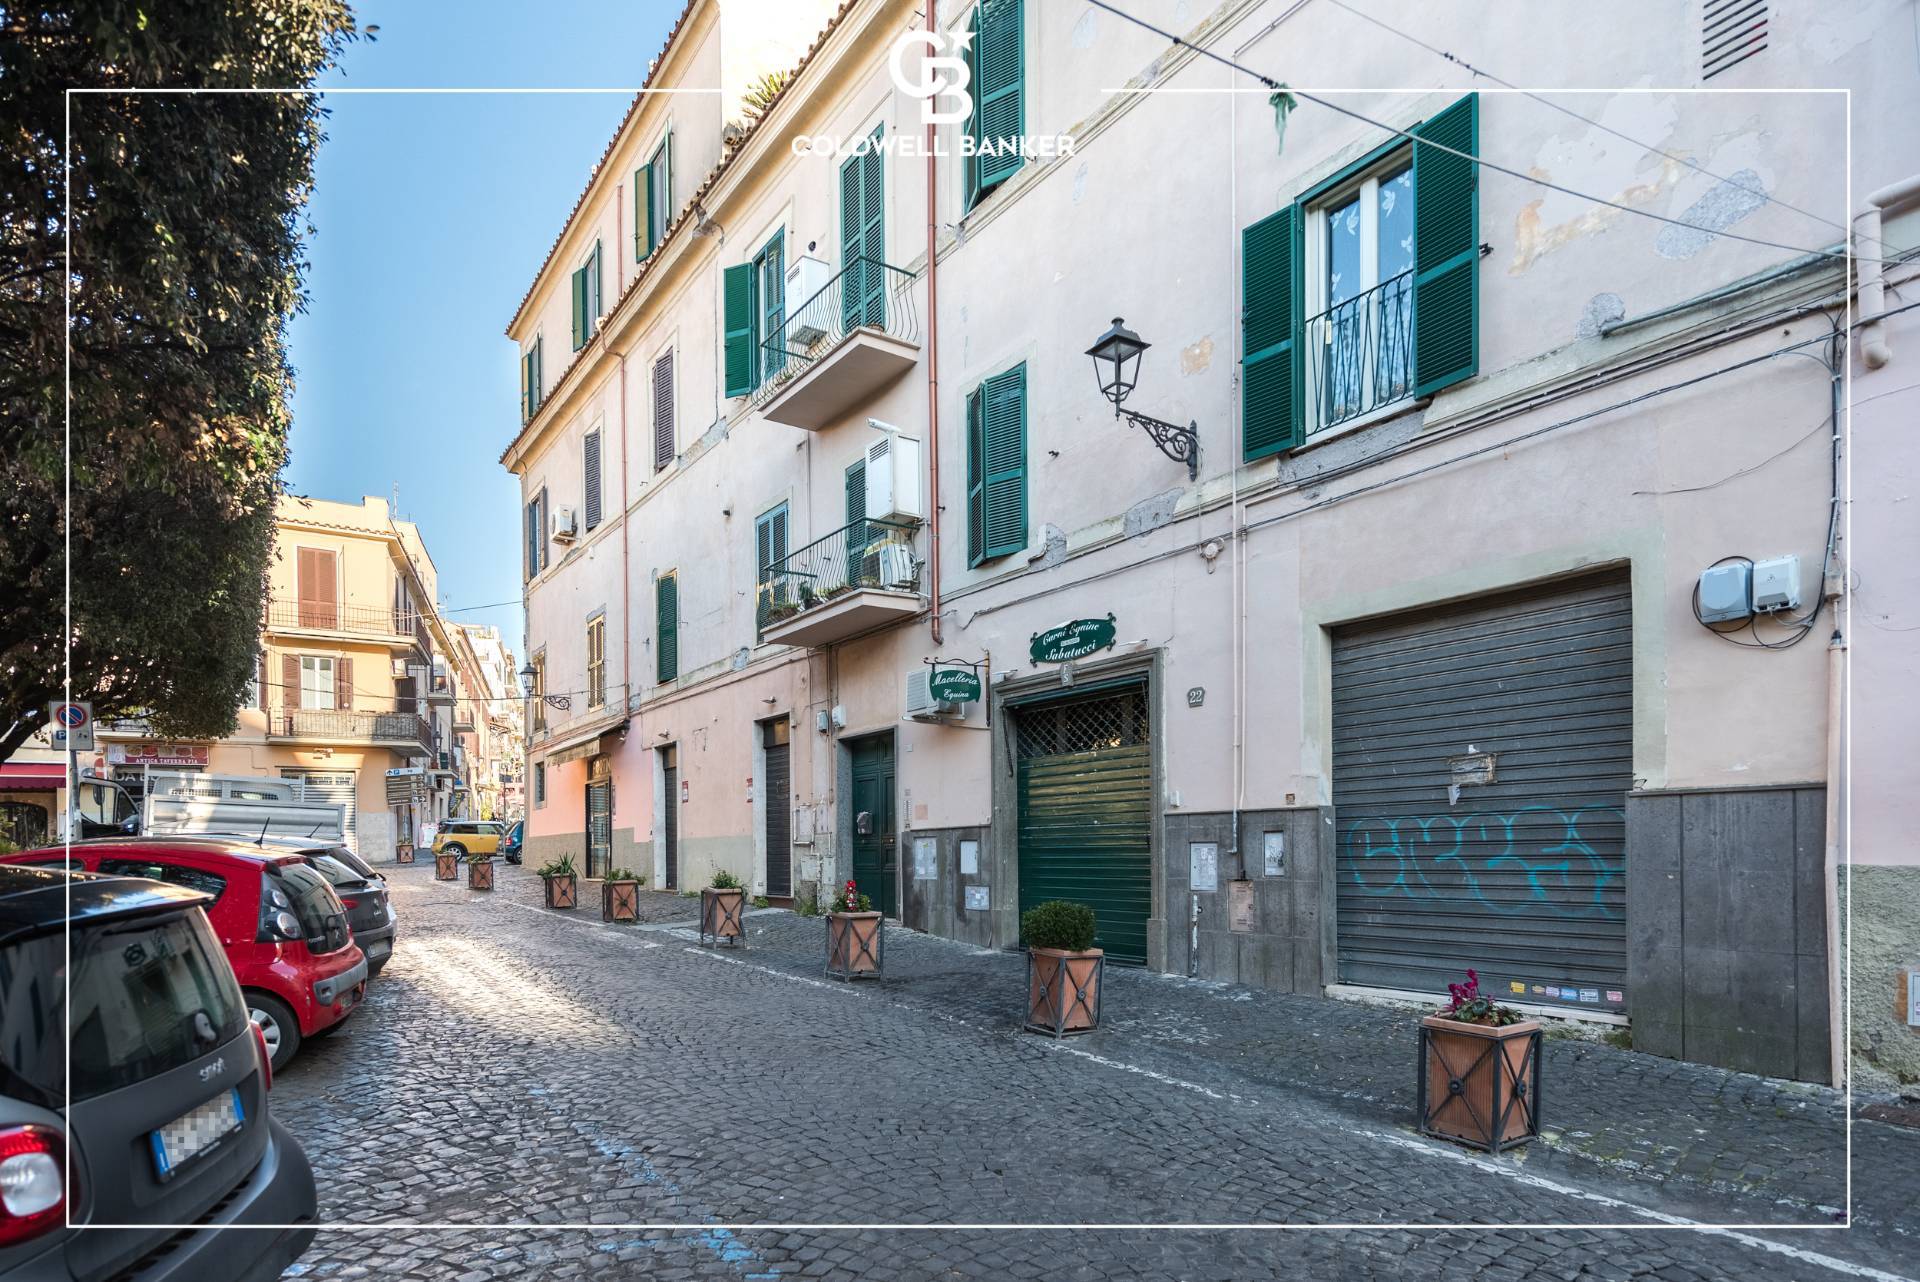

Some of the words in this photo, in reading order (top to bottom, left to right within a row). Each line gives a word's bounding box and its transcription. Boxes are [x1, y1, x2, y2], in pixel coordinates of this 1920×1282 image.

[1042, 628, 1068, 646] Carni
[1069, 621, 1100, 637] Equine
[1045, 639, 1097, 661] Sabatucci
[932, 672, 978, 687] Macelleria
[943, 688, 969, 701] Equina
[1190, 690, 1203, 704] 22
